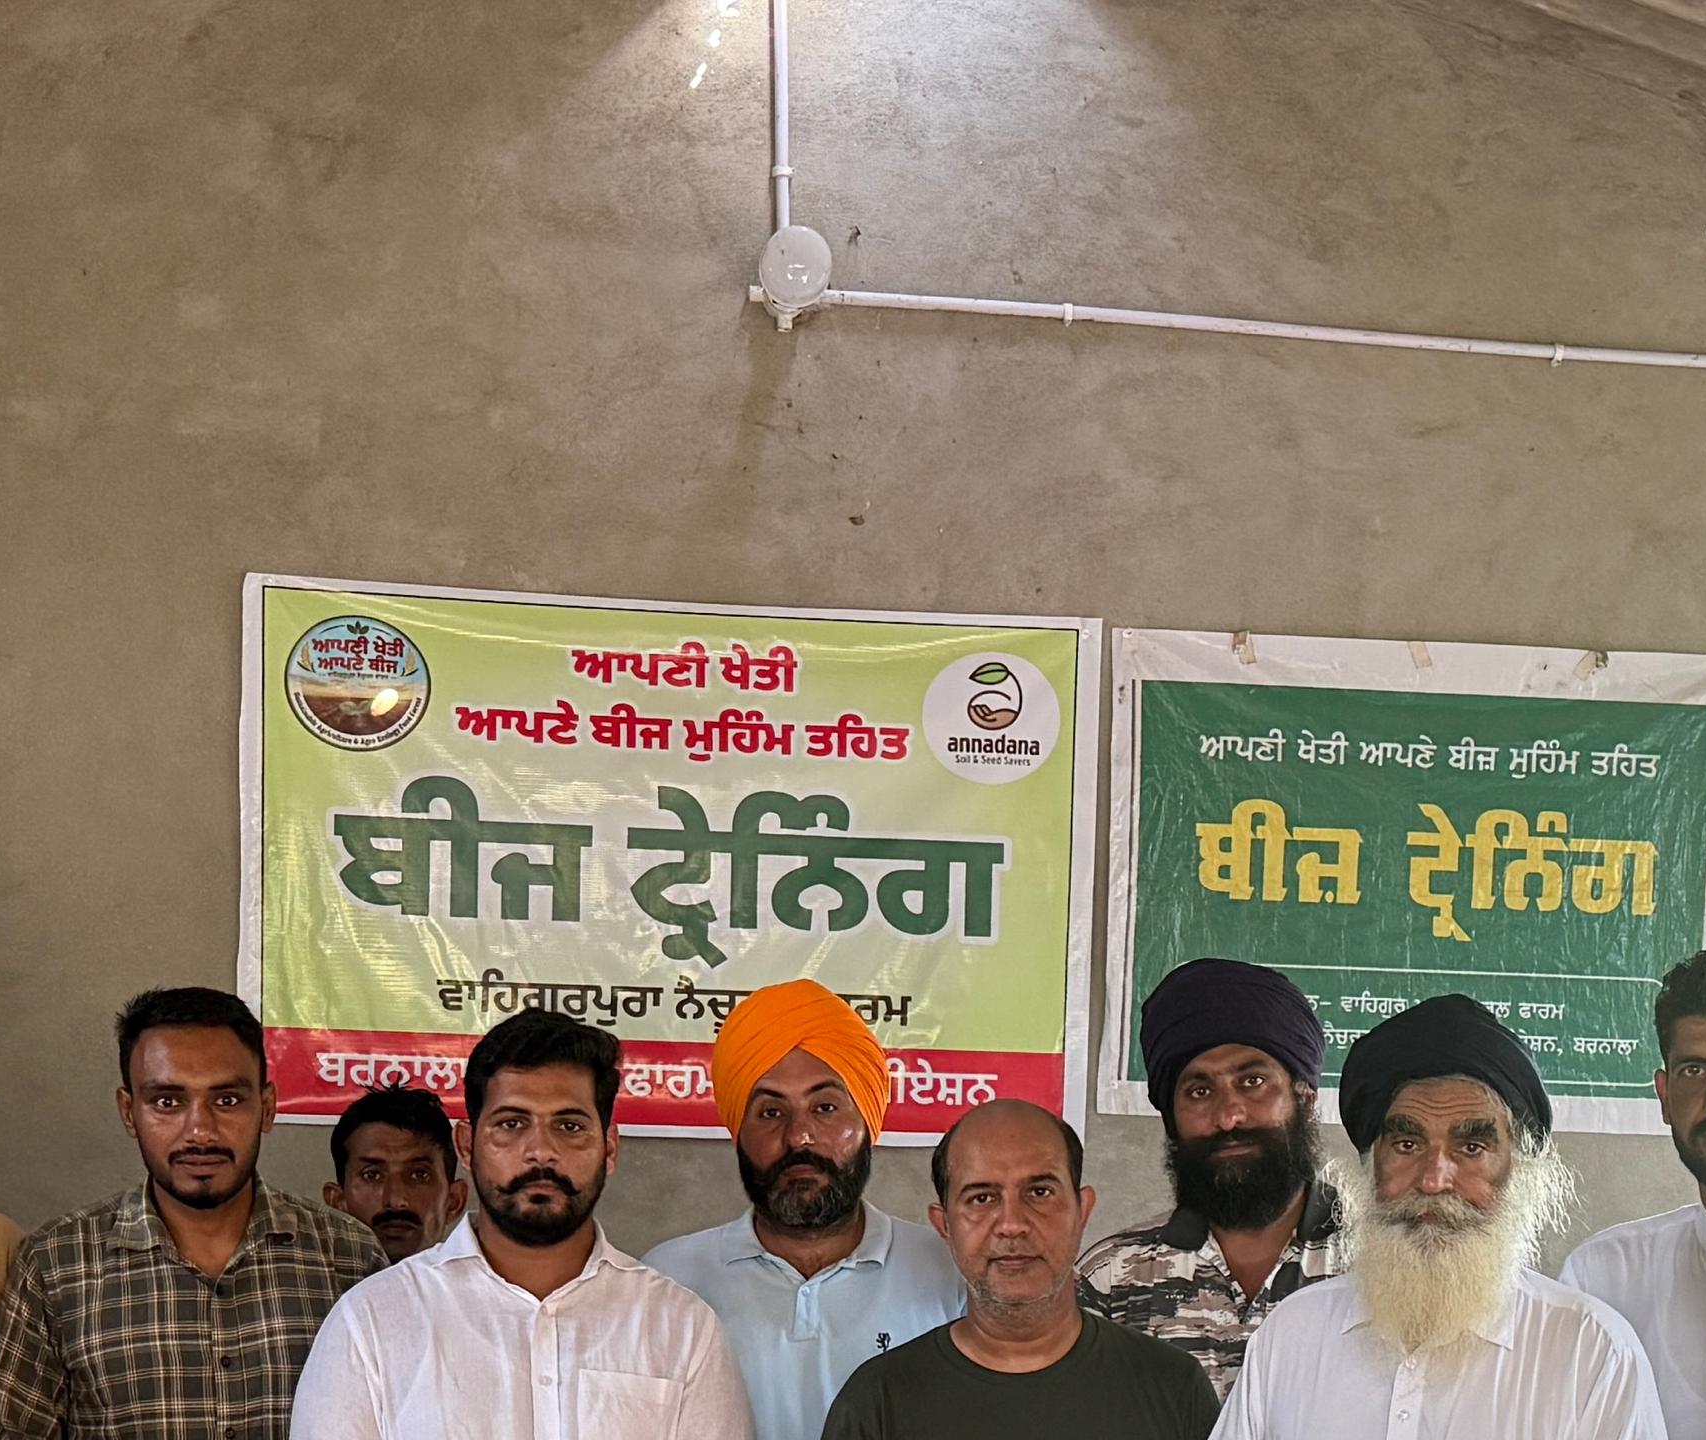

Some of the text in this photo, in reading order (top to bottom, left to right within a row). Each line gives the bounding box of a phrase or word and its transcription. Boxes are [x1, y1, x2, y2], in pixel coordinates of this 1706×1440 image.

[313, 636, 404, 657] ਆਪਣੀ ਖੇਤੀ
[318, 656, 398, 673] ਆਪਣੇ ਬੀਜ
[572, 642, 797, 692] ਆਪਣੀ ਖੇਤੀ
[456, 700, 910, 761] ਆਪਣੇ ਬੀਜ ਮੁਹਿੰਮ ਤਹਿਤ
[948, 734, 1039, 755] annadana
[956, 755, 1031, 766] Soil & Seed Savers
[1199, 728, 1285, 763] ਆਪਣੀ
[1297, 730, 1348, 766] ਖੇਤੀ
[1359, 735, 1437, 769] ਆਪਣੇ
[1510, 739, 1579, 779] ਮੁਹਿੰਮ
[1591, 744, 1660, 778] ਤਹਿਤ
[334, 776, 1004, 969] ਬੀਜ ਟ੍ਰੇਨਿੰਗ
[1408, 804, 1656, 941] ਟ੍ਰੇਨਿੰਗ
[837, 994, 912, 1026] ਰਮ
[1518, 1002, 1565, 1020] ਫਾਰਮ
[1573, 1037, 1639, 1056] ਬਰਨਾਲਾ
[316, 1052, 467, 1090] ਬਰਨਾਲਾ
